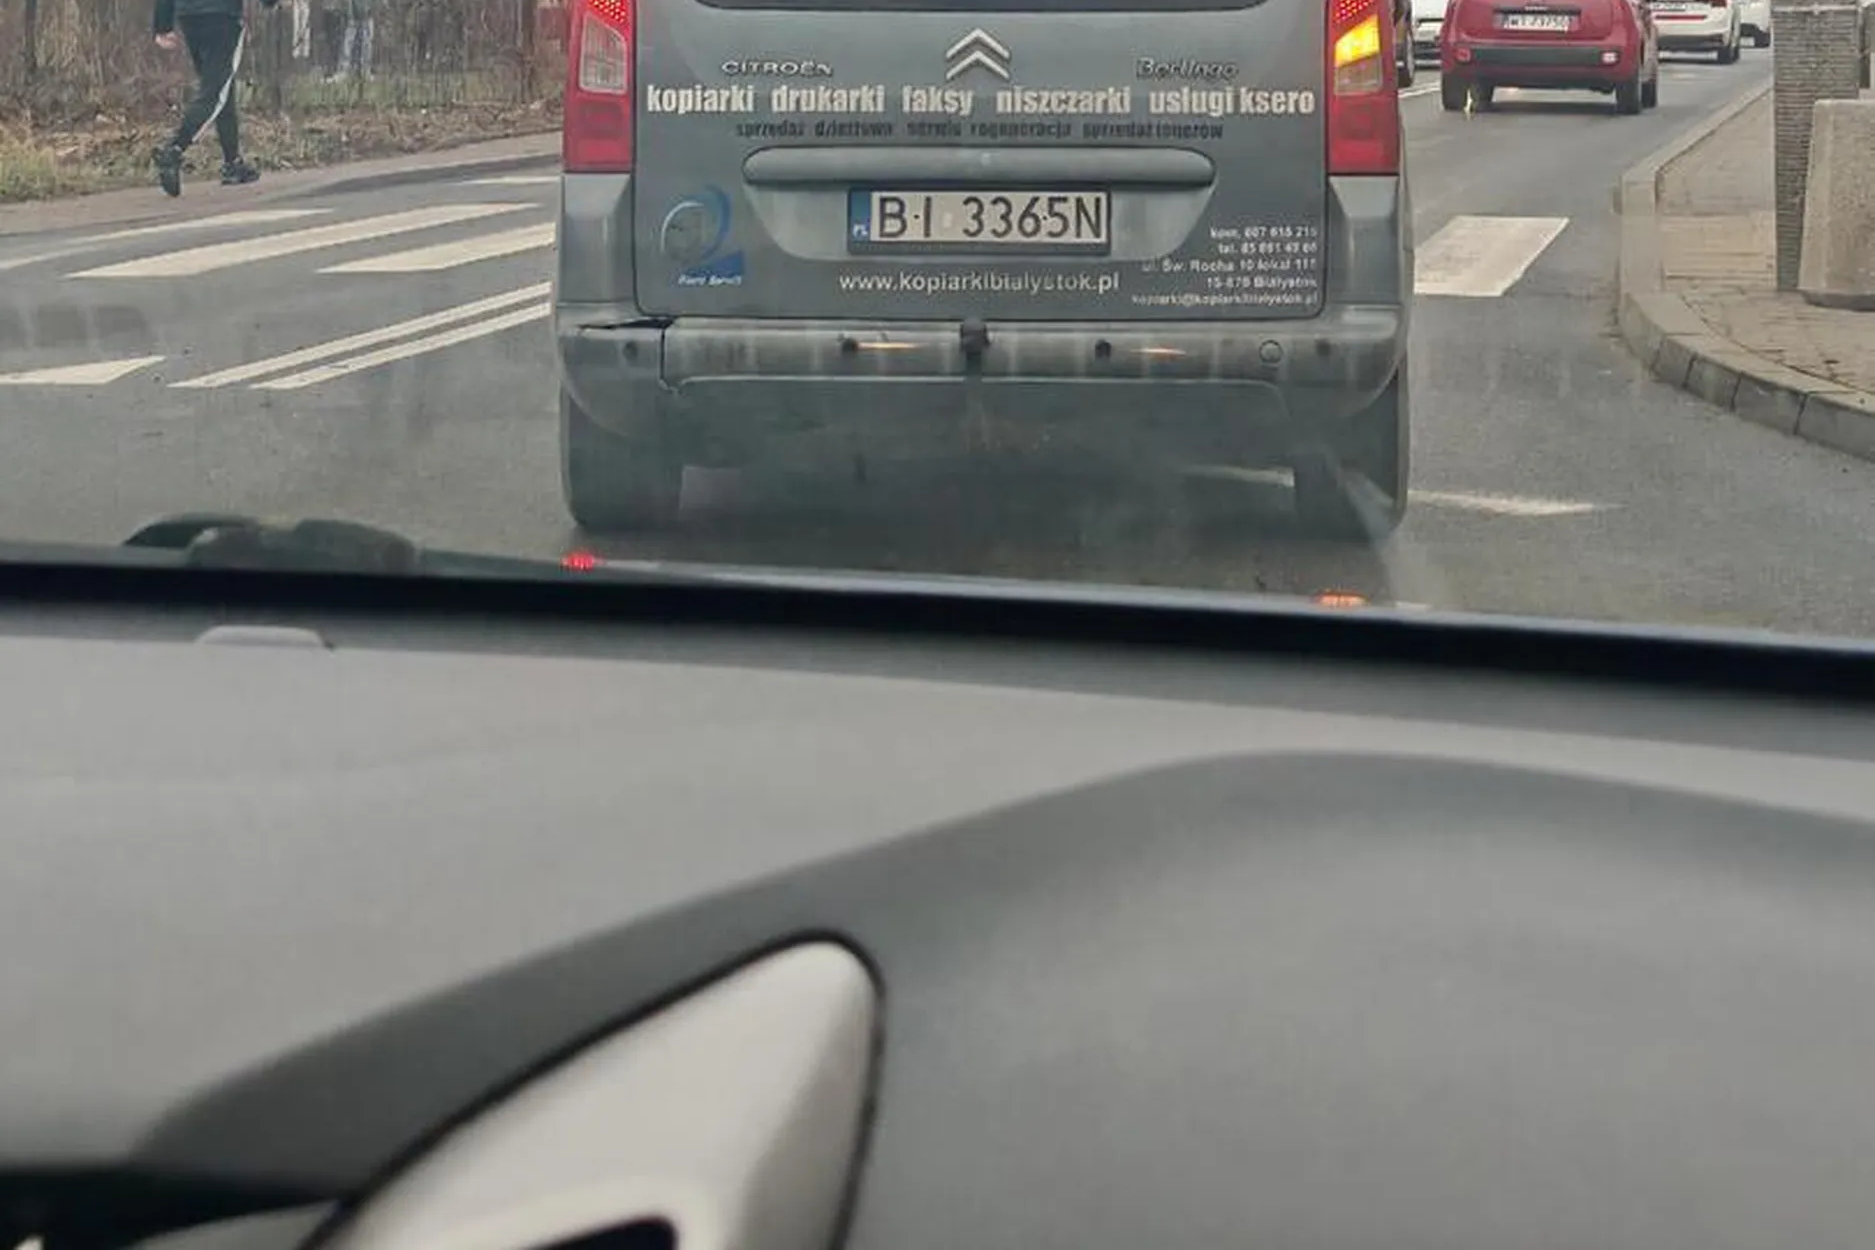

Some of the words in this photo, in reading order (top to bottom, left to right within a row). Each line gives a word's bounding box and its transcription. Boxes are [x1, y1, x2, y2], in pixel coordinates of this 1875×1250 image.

[1136, 57, 1240, 81] Berlingo
[647, 84, 755, 114] kopiarki
[771, 85, 886, 113] drukarki
[996, 85, 1131, 115] niszczarki
[1239, 86, 1316, 115] ksero
[878, 196, 933, 239] BI
[962, 196, 1103, 239] 3365N
[1190, 260, 1235, 272] Rocha
[839, 270, 1120, 296] www.kopiarkibialystok.pl
